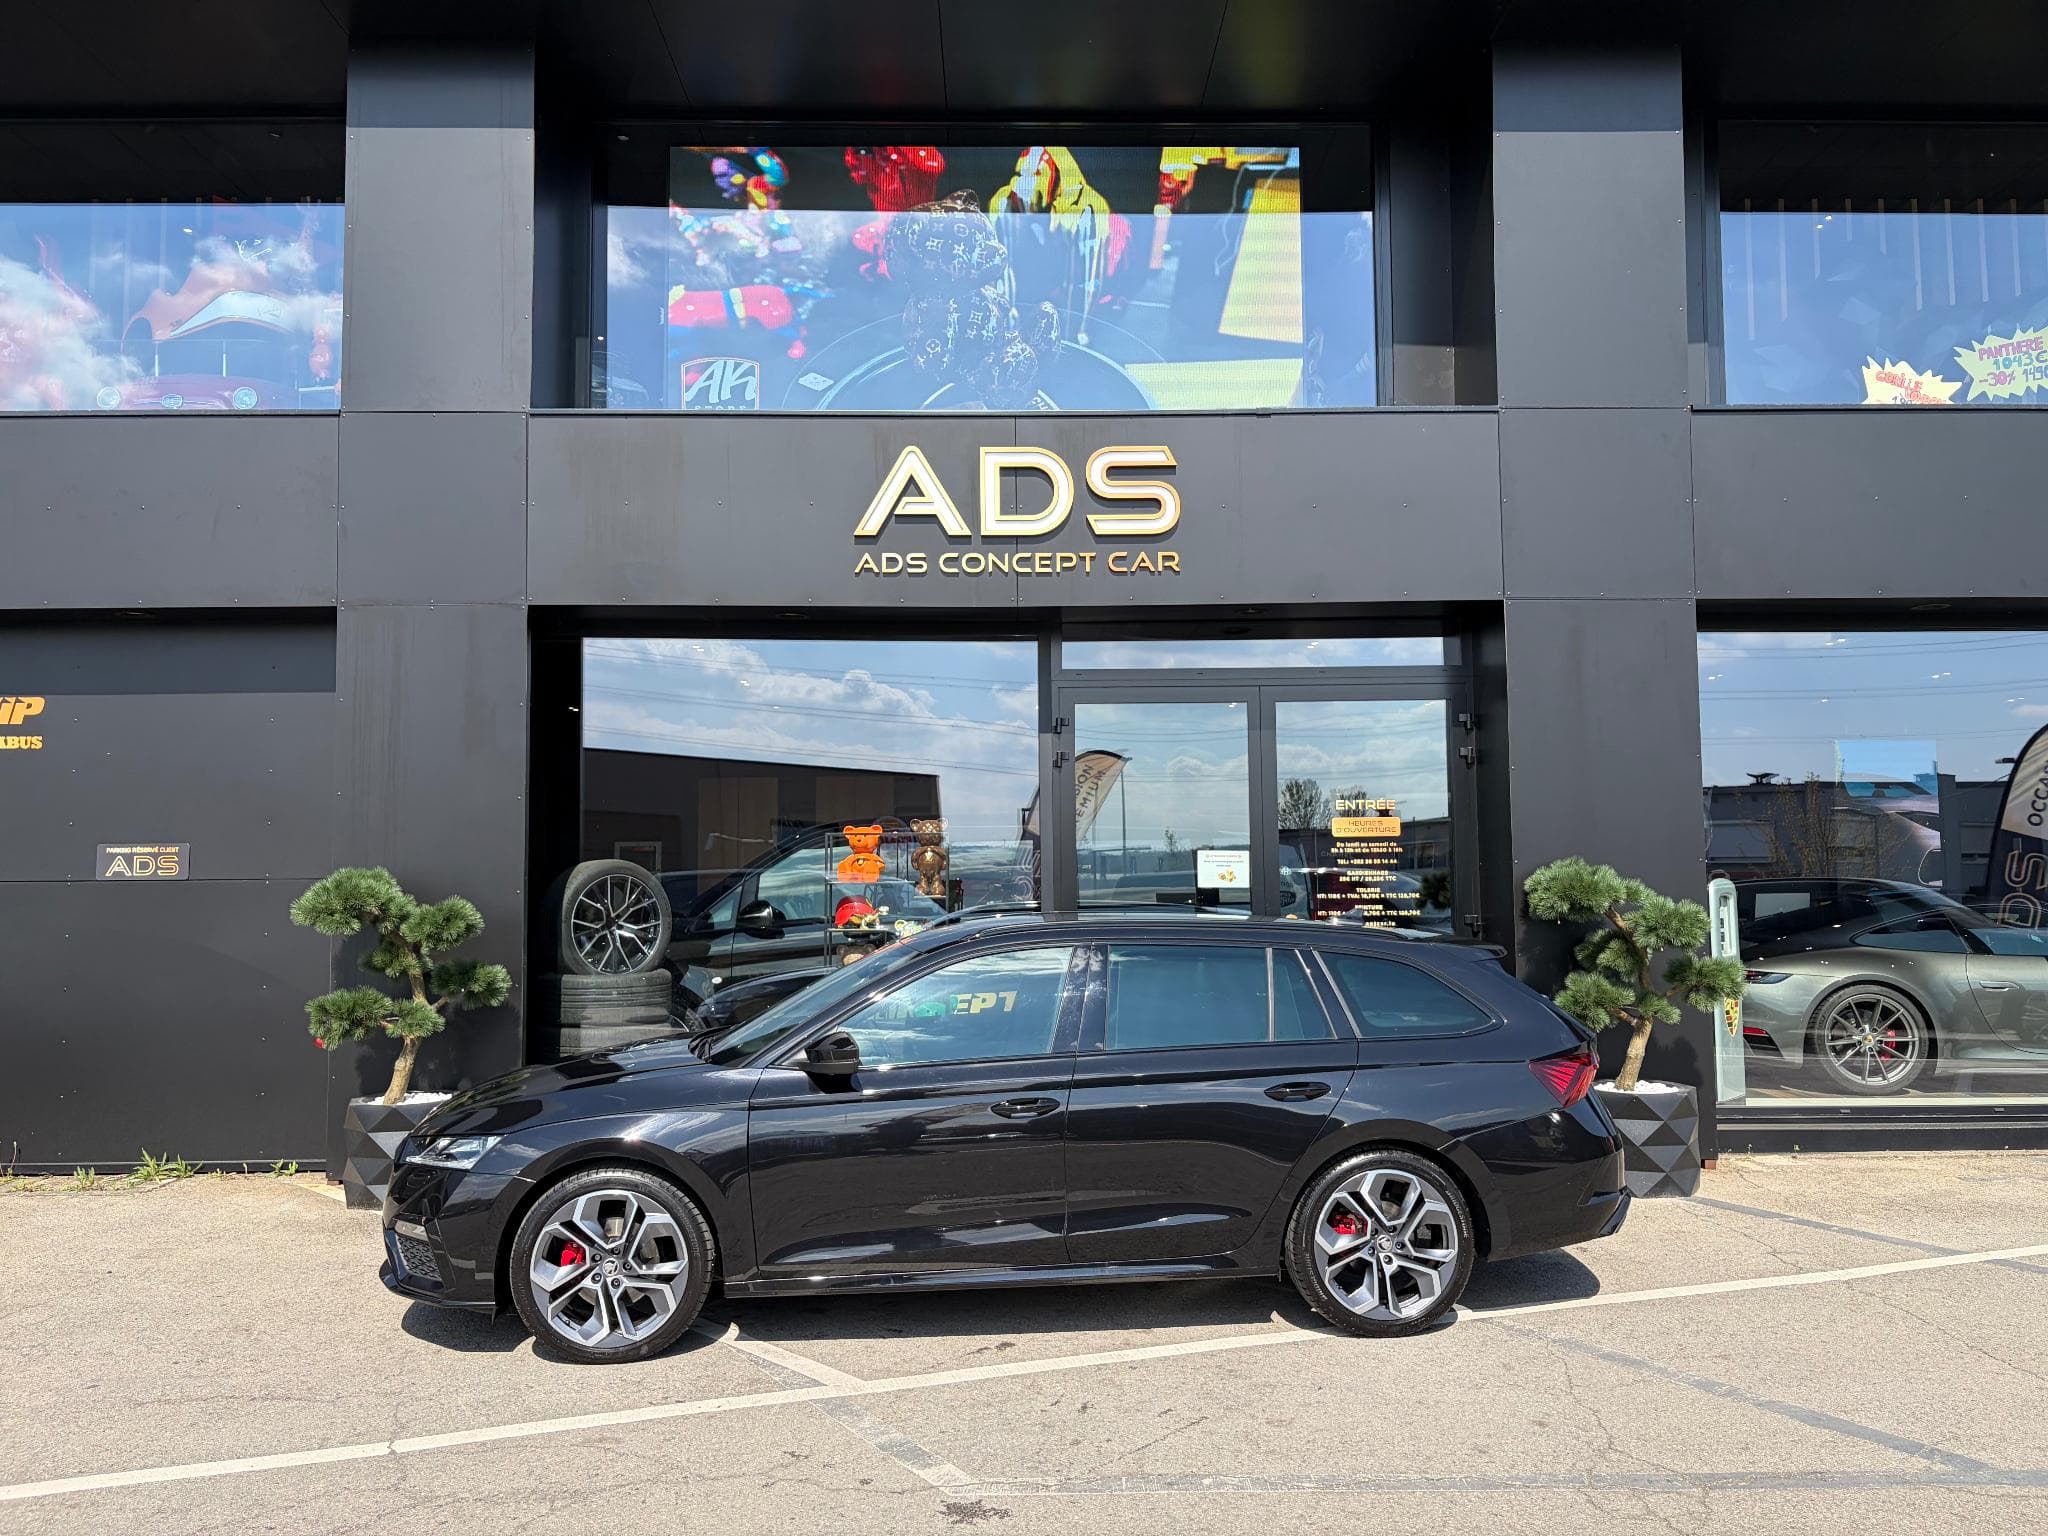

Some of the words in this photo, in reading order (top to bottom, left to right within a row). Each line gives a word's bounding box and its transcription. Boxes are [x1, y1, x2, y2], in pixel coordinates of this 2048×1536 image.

[853, 445, 1182, 536] ADS
[854, 552, 928, 573] ADS
[939, 551, 1097, 573] CONCEPT
[1107, 551, 1181, 572] CAR
[105, 855, 180, 877] ADS
